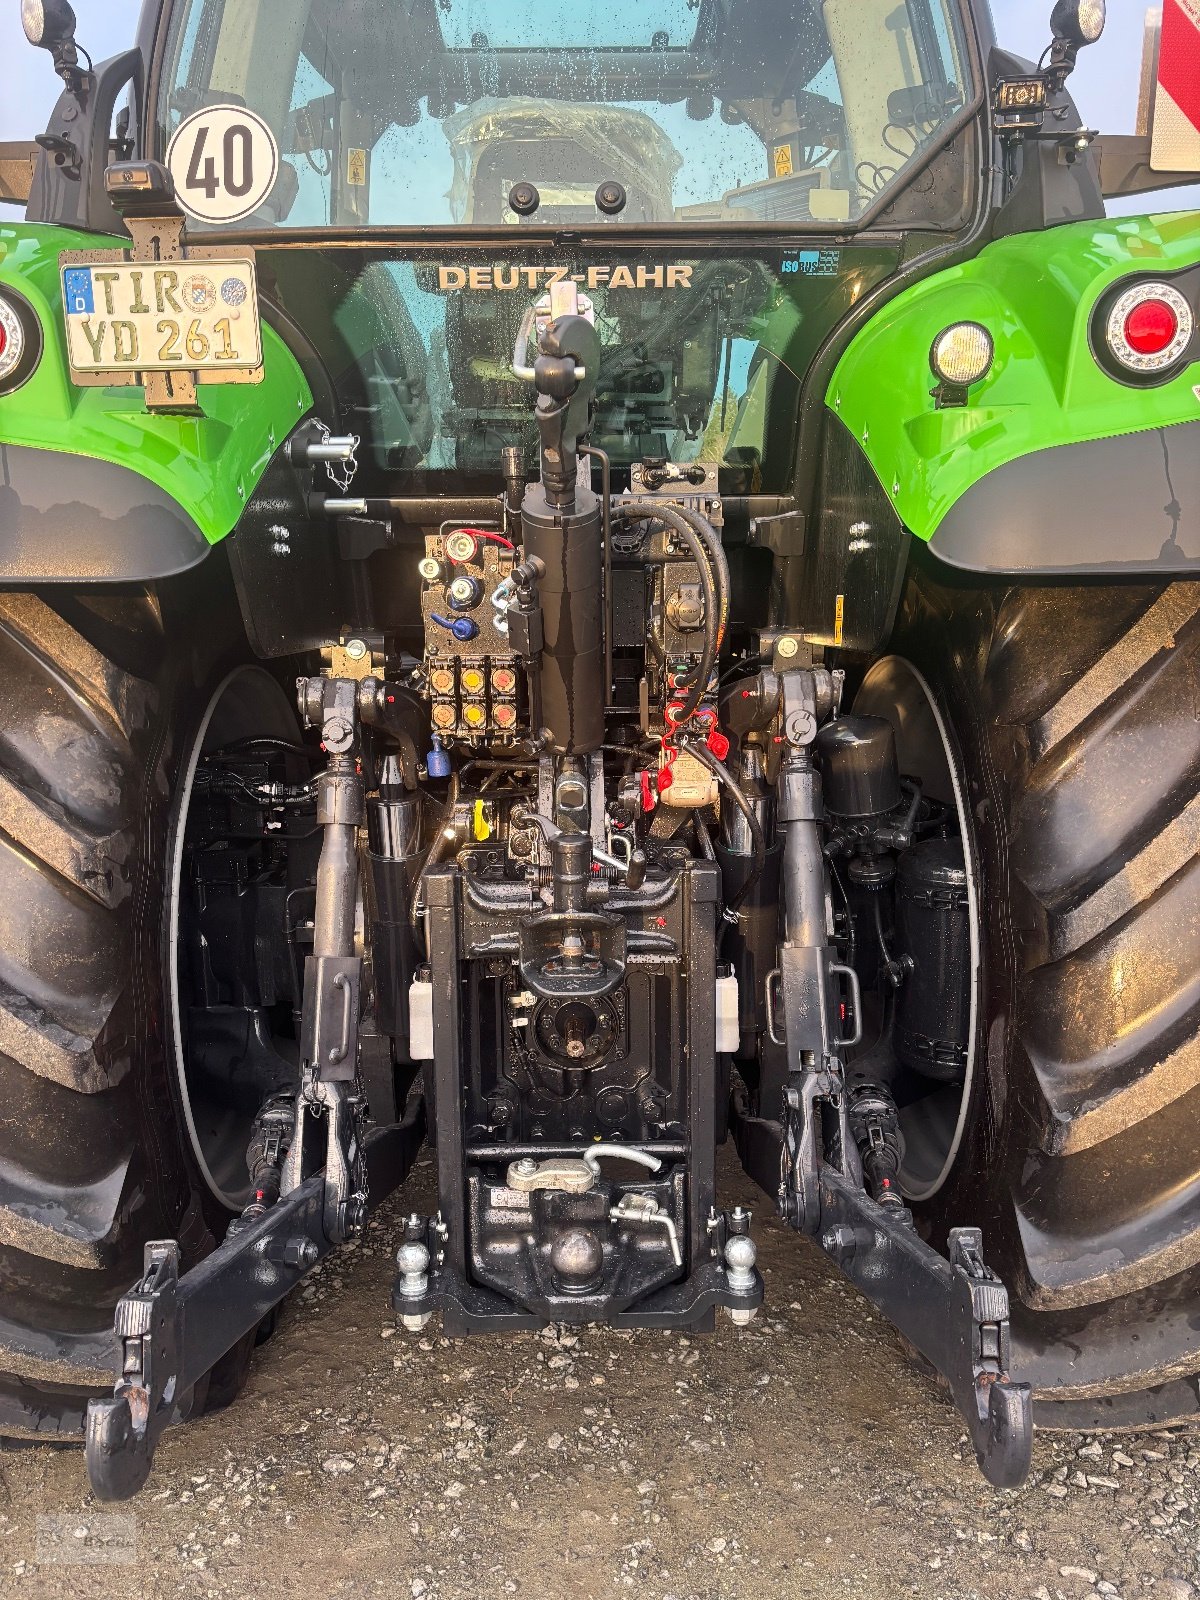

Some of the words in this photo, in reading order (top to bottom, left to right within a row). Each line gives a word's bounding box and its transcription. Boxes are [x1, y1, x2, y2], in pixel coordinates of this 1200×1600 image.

[185, 124, 254, 199] 40
[94, 270, 183, 315] TIR
[438, 265, 694, 291] DEUTZ-FAHR
[75, 297, 86, 311] D
[81, 319, 140, 363] YD
[156, 317, 239, 361] 261
